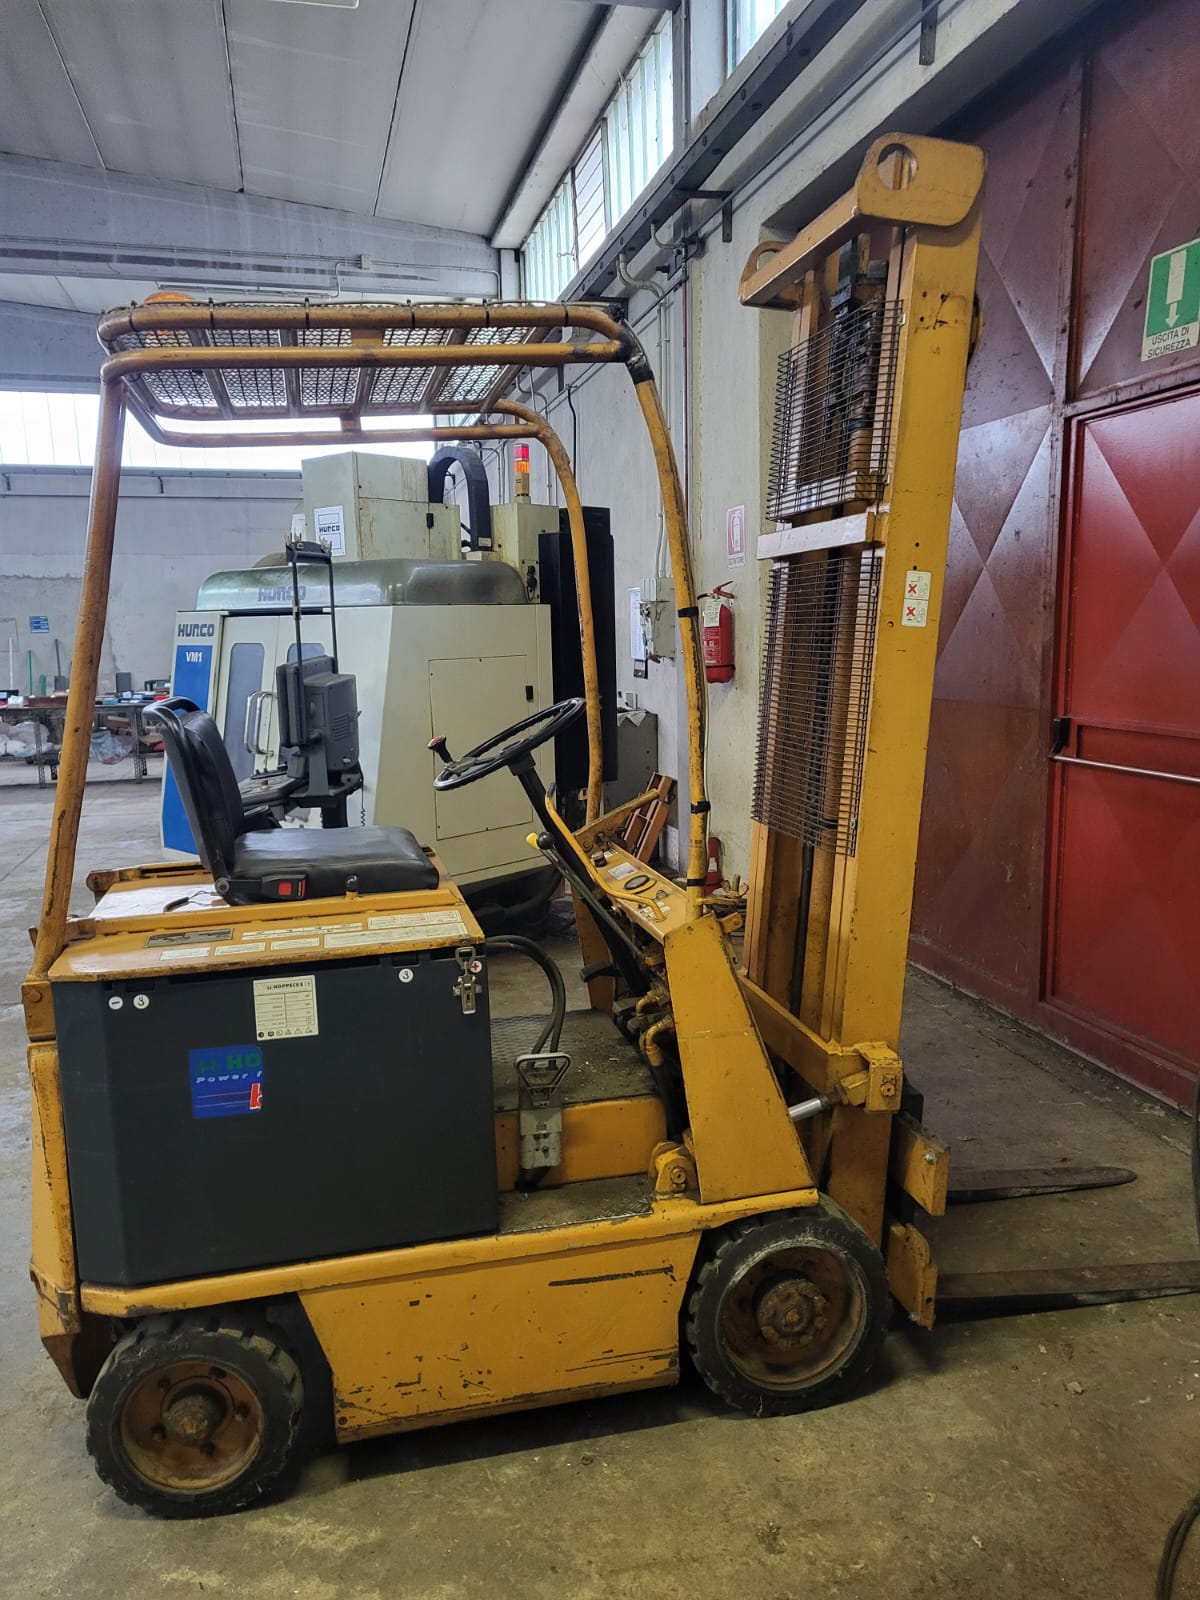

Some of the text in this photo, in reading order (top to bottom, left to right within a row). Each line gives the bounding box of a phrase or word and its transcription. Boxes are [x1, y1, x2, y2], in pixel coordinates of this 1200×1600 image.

[1152, 326, 1189, 345] USCITA DI
[1147, 338, 1190, 358] SICUREZZA
[319, 525, 340, 533] HURCO
[178, 623, 215, 637] HURCO
[186, 651, 202, 662] VM1
